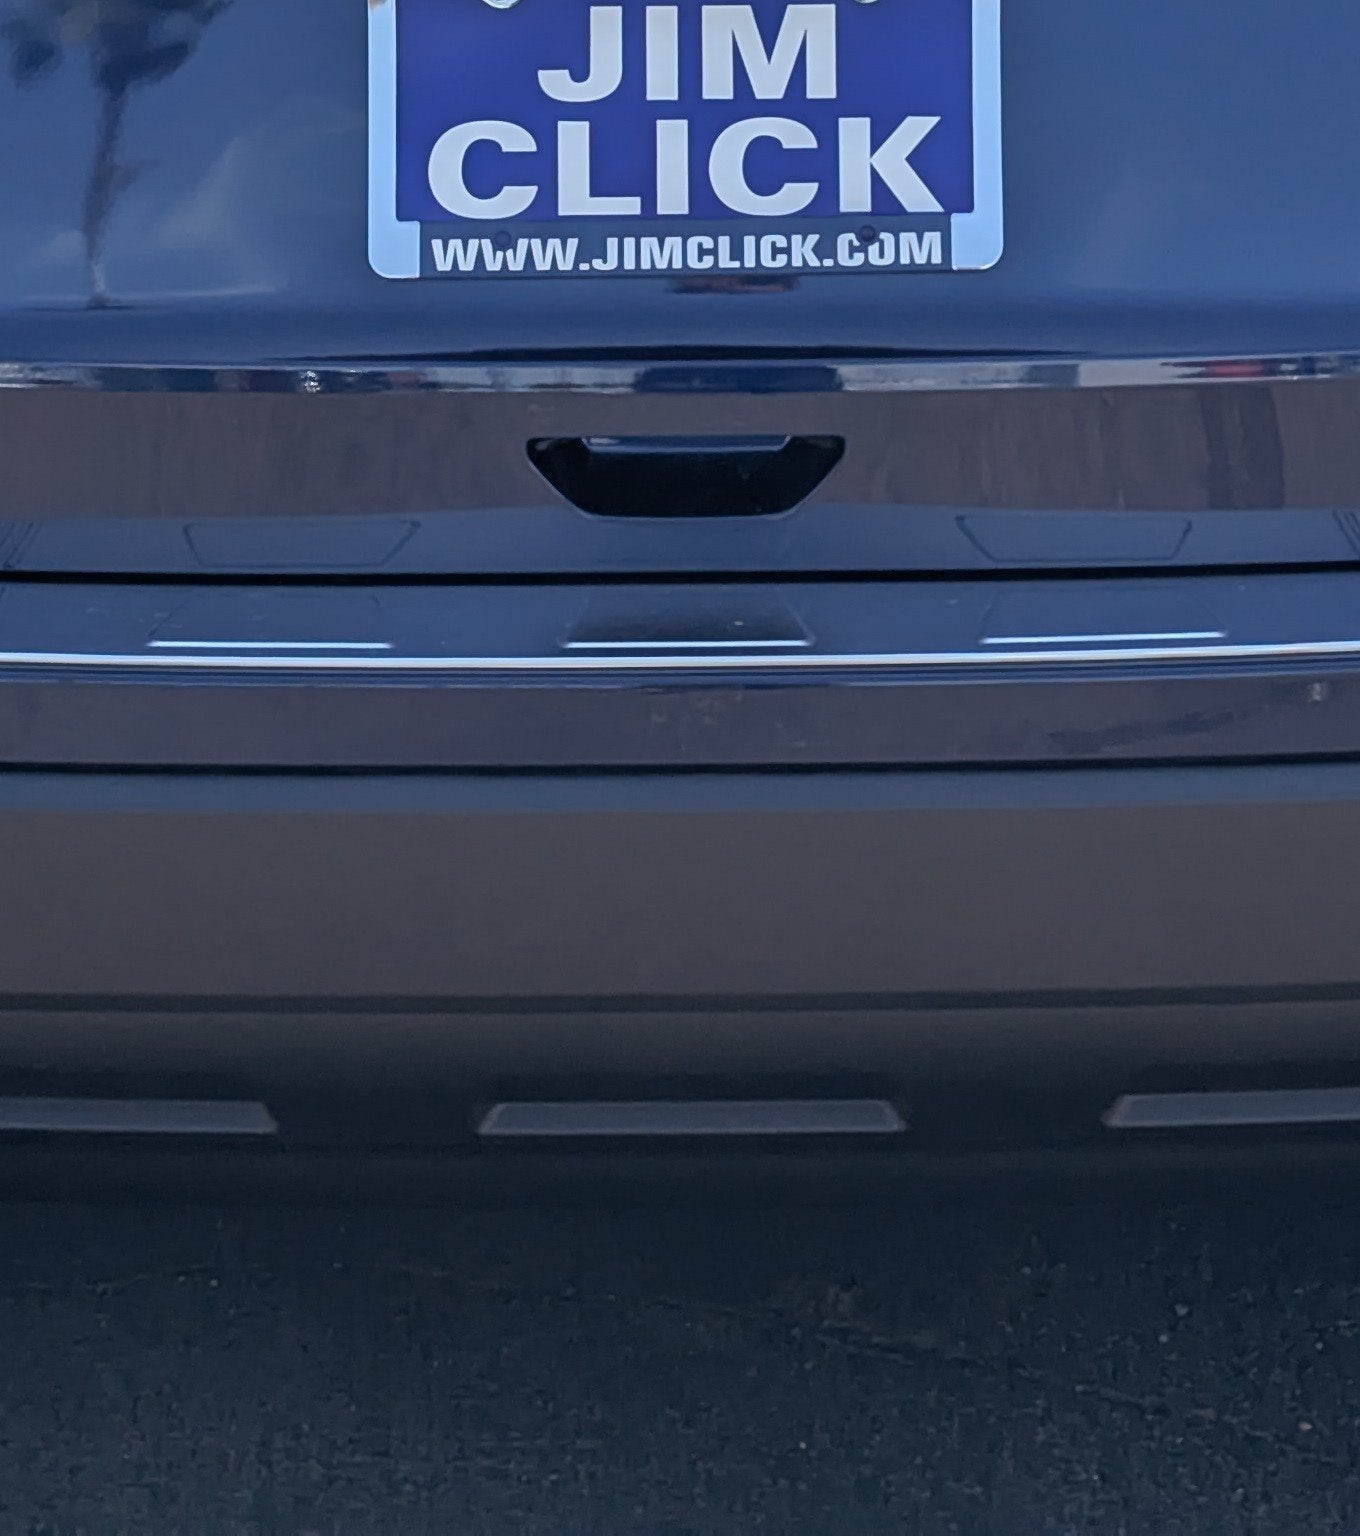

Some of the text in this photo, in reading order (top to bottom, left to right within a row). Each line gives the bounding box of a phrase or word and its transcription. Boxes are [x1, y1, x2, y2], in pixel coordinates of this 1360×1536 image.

[537, 3, 837, 103] JIM
[427, 116, 945, 219] CLICK
[430, 231, 943, 273] WWW.JIMCLICK.COM
